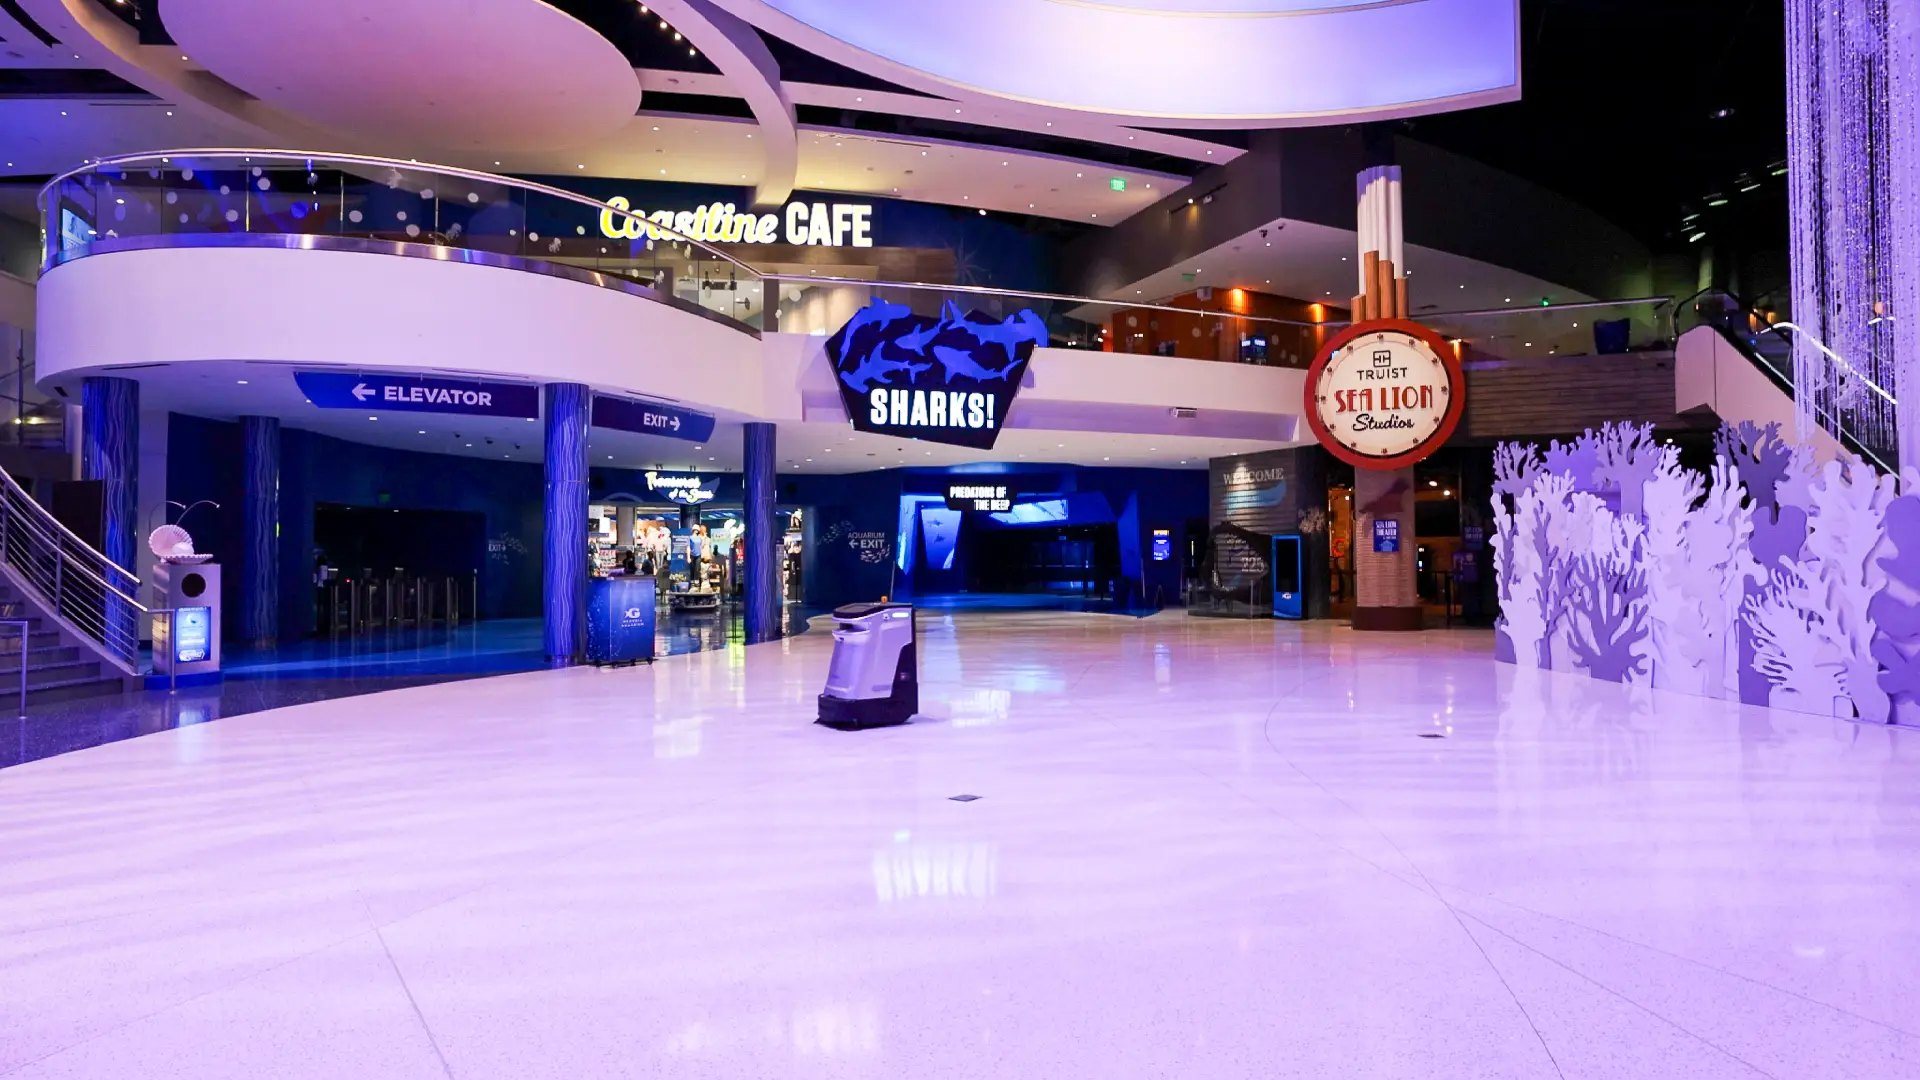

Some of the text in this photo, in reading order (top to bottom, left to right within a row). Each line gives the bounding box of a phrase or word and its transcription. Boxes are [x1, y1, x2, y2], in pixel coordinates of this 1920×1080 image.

[600, 196, 872, 248] Coastline CAFE
[1357, 367, 1407, 380] TRUIST
[384, 386, 492, 406] ELEVATOR
[1334, 385, 1432, 413] SEA LION
[870, 388, 995, 429] SHARKS!
[643, 412, 668, 429] EXIT
[1352, 413, 1414, 431] Studios
[1223, 468, 1284, 485] WELCOME
[949, 486, 1006, 498] PREDATORS OF
[973, 499, 1010, 511] THE DEEP
[860, 539, 885, 549] EXIT
